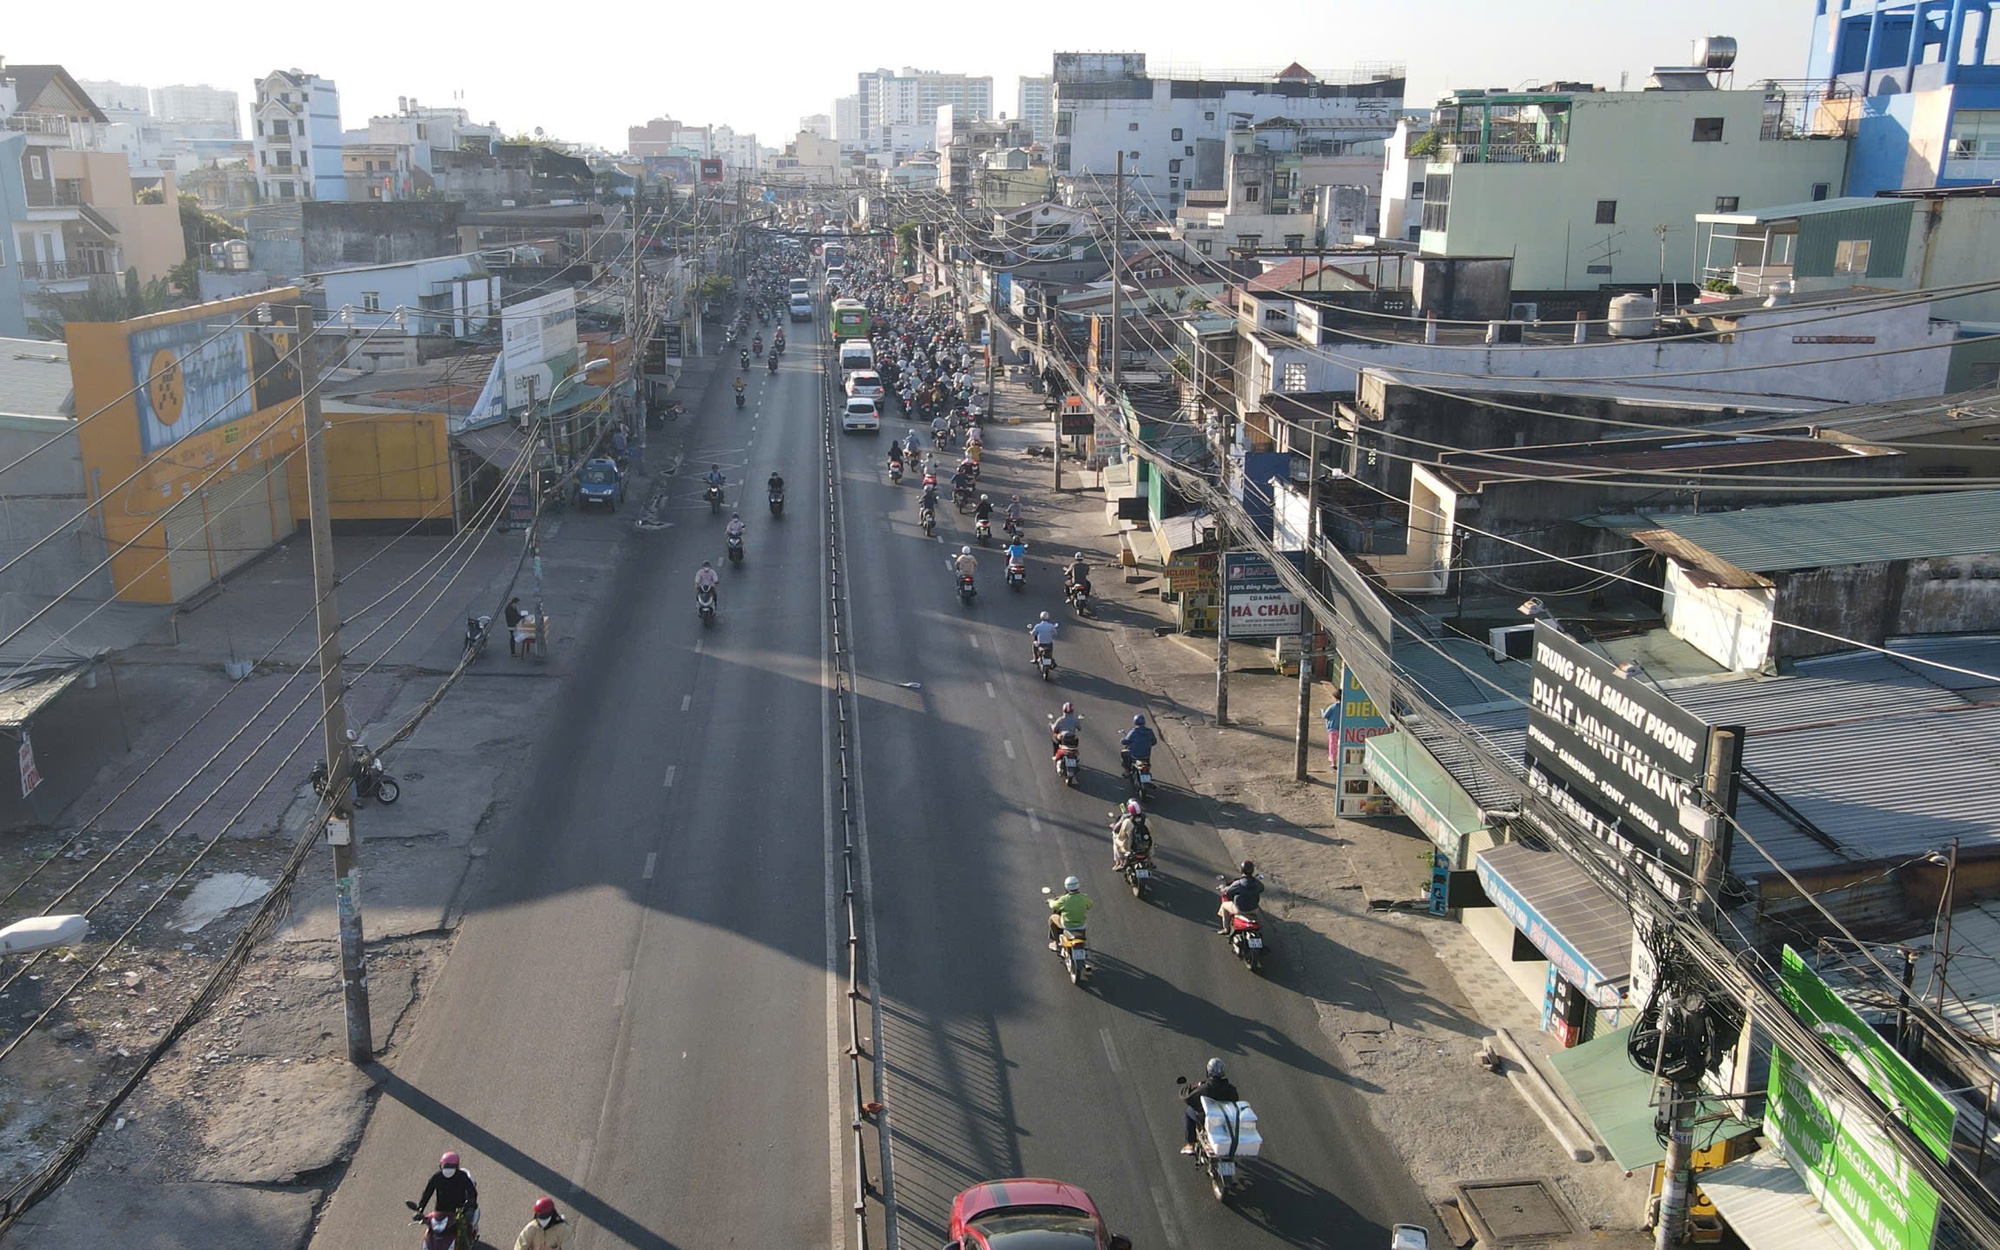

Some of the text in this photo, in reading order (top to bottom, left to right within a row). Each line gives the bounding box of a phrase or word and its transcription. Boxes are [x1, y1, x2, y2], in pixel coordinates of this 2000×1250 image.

[1532, 677, 1574, 723] PHÁT
[1537, 642, 1698, 764] TRUNG TÂM SMART PHONE
[1528, 724, 1690, 857] IPHONE SAMSUNG SONY NOKIA VIVO
[1838, 1174, 1858, 1209] RAU
[1856, 1195, 1870, 1227] MÁ
